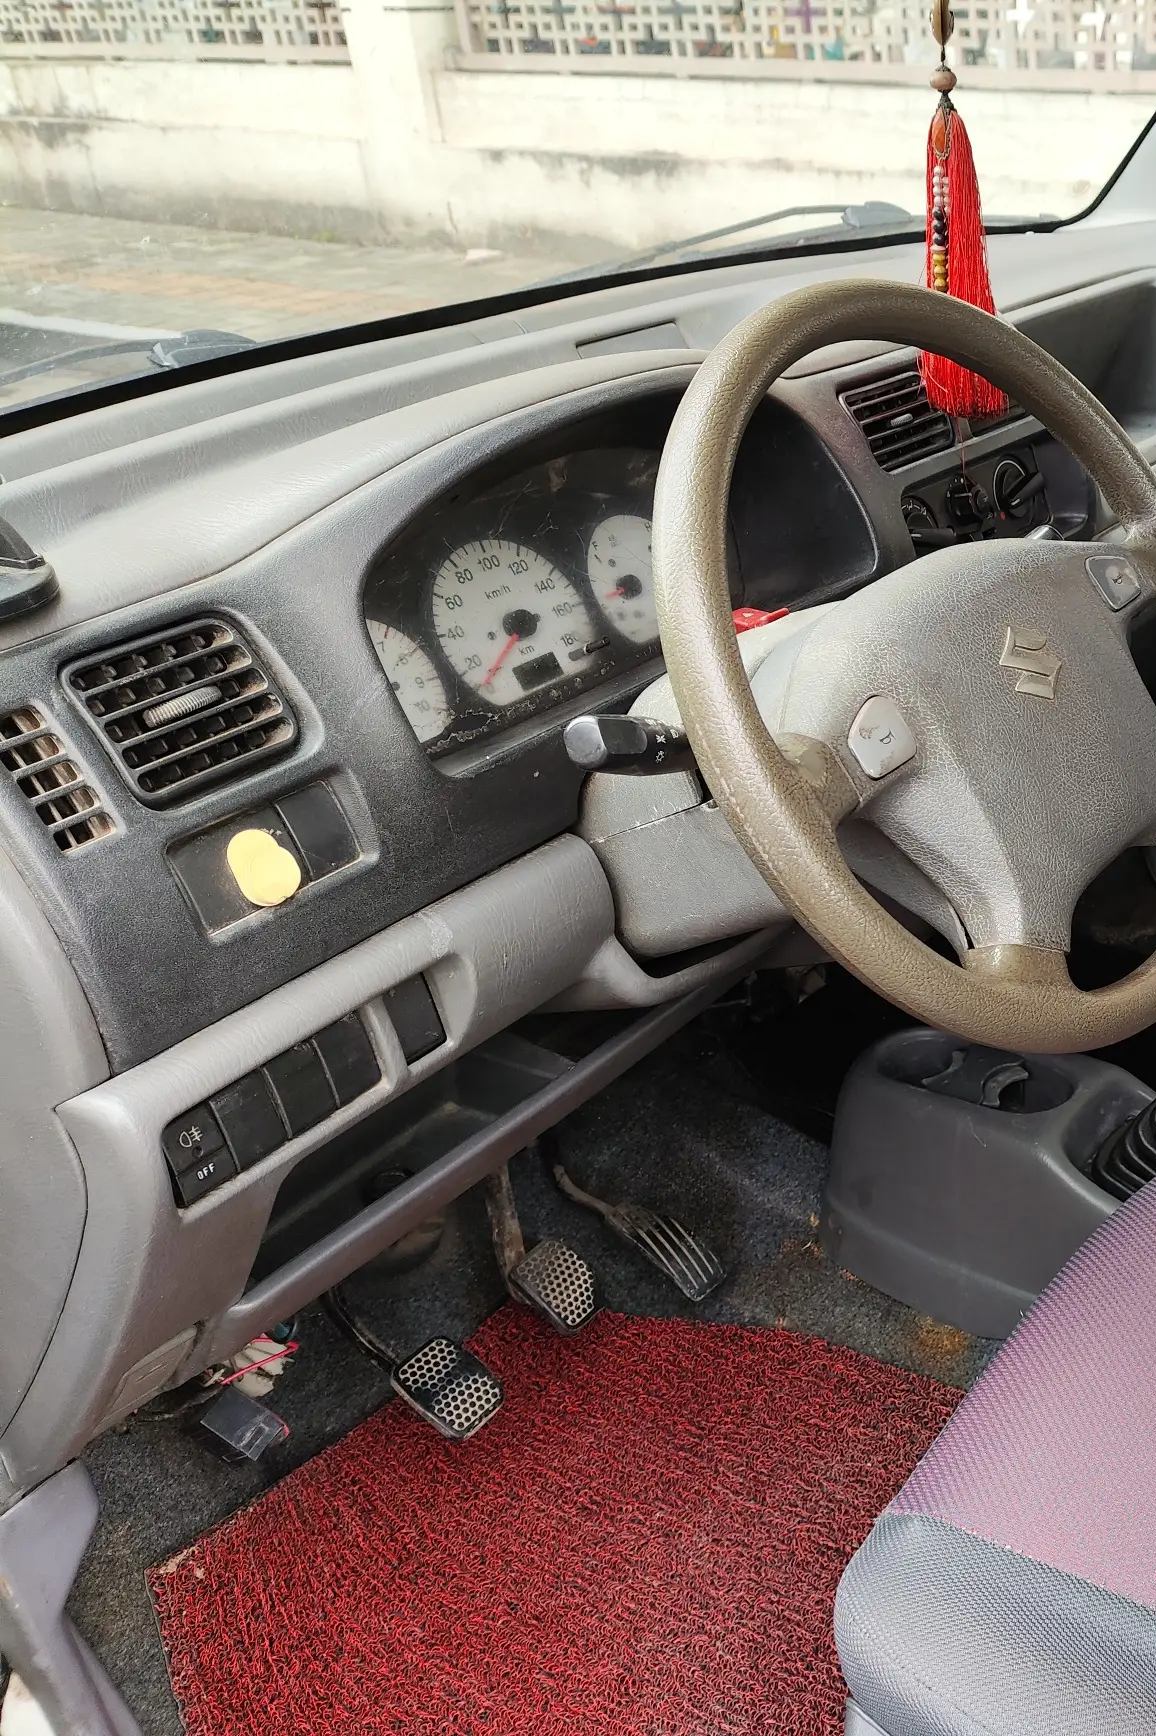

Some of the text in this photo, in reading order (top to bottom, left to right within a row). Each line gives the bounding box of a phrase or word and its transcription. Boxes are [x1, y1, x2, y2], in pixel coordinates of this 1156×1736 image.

[477, 554, 501, 572] 100
[507, 559, 529, 576] 120
[455, 568, 474, 584] 80
[484, 585, 511, 600] km/h
[534, 577, 556, 594] 140
[444, 594, 464, 611] 60
[551, 601, 573, 618] 160
[447, 625, 465, 641] 40
[518, 644, 535, 656] km
[464, 654, 482, 671] 20
[414, 676, 425, 690] 9
[197, 1163, 215, 1180] OFF
